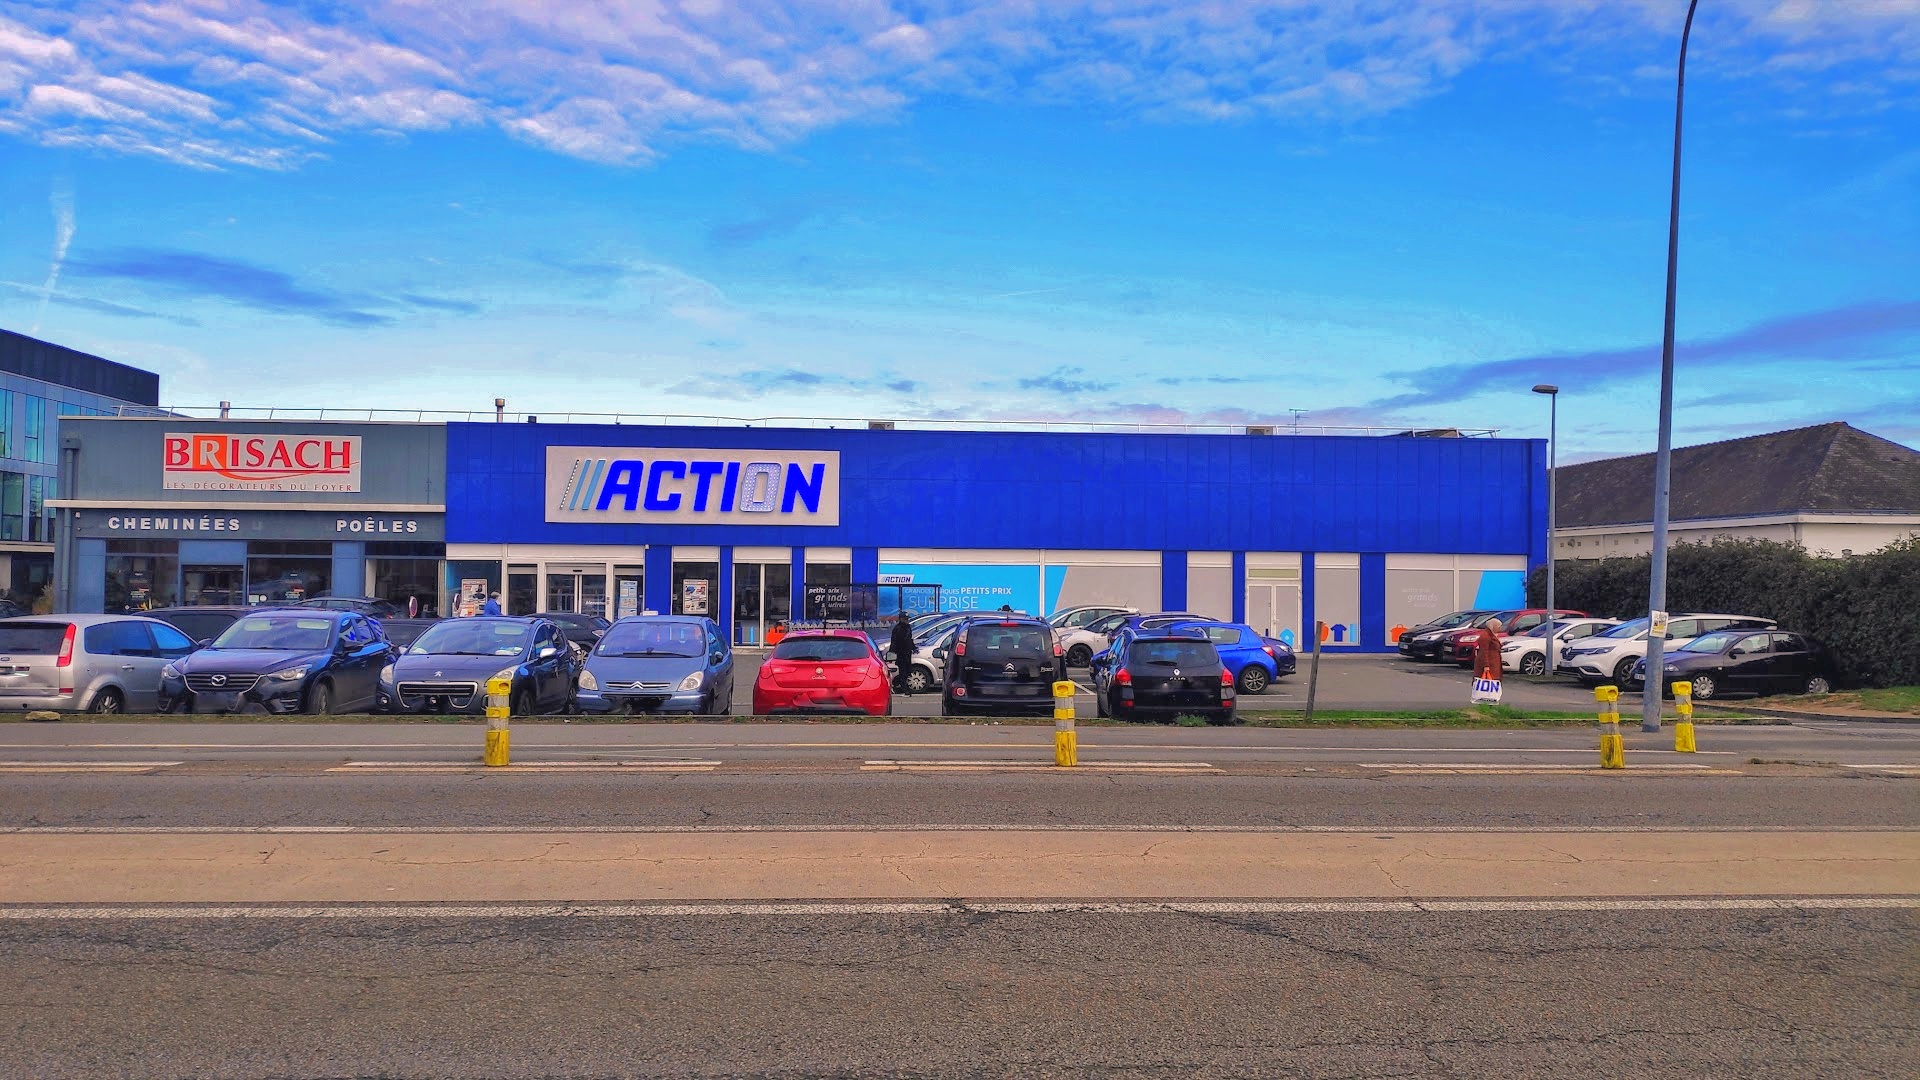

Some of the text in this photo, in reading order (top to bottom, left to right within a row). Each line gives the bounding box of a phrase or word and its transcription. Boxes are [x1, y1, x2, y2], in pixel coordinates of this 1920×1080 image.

[165, 437, 350, 469] BRISACH
[194, 481, 282, 490] DÉCORATEURS
[290, 483, 306, 491] DU
[314, 483, 352, 492] FOYER
[595, 459, 826, 513] ACTION
[108, 515, 240, 531] CHEMINÉES
[336, 517, 418, 533] POÊLES
[960, 587, 990, 595] PETITS
[992, 587, 1012, 595] PRIX
